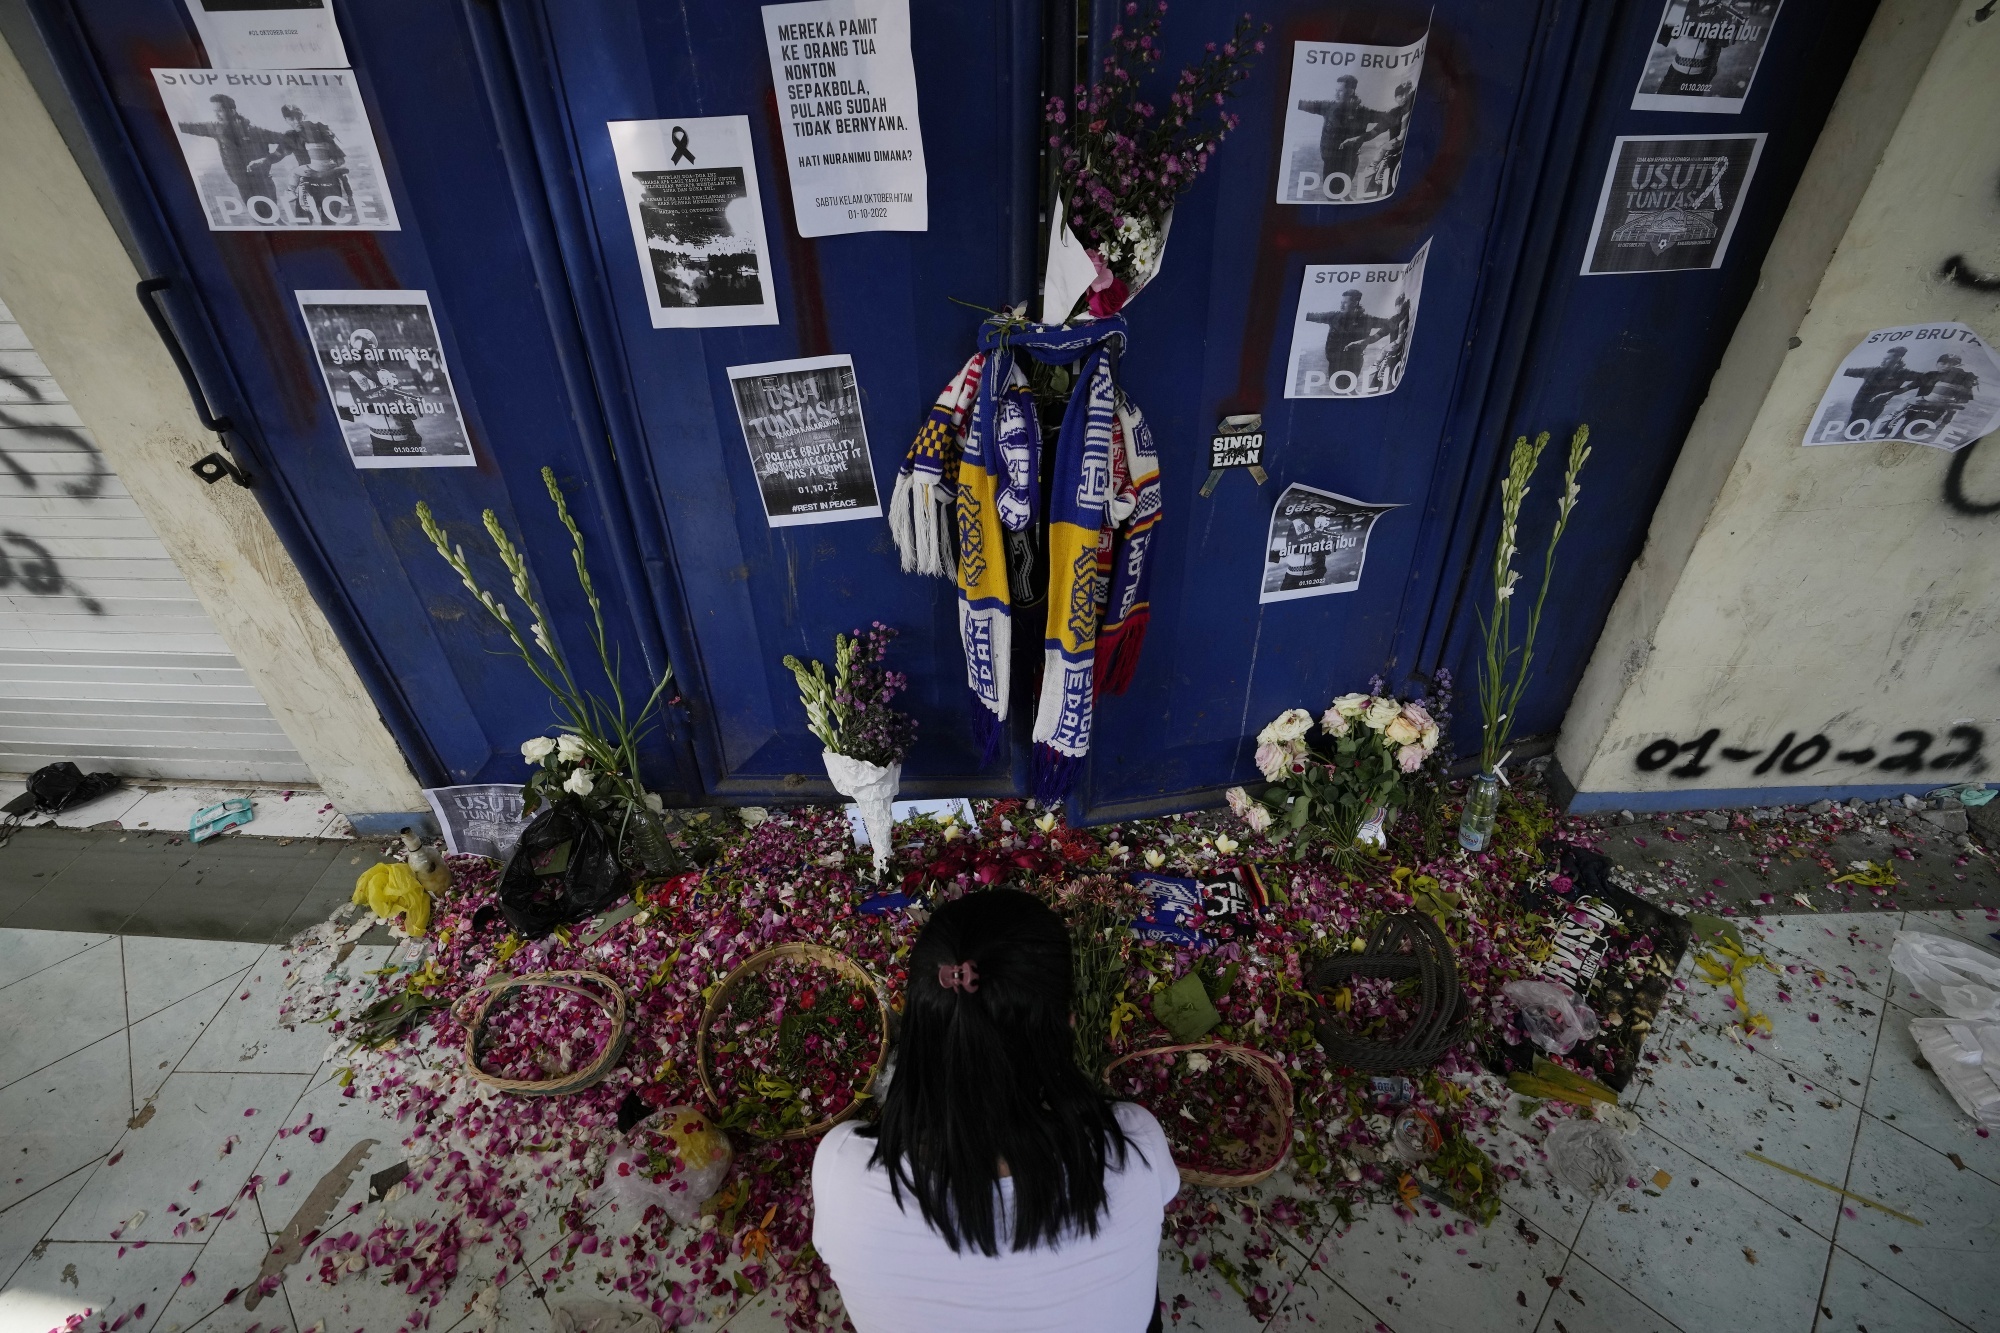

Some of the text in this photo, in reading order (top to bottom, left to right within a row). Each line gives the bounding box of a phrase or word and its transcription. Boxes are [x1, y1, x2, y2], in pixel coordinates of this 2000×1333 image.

[778, 18, 878, 42] MEREKA PAMIT
[1671, 15, 1761, 42] air mata ibu
[781, 39, 876, 61] KE ORANG TUA
[1306, 49, 1356, 67] STOP
[784, 62, 837, 81] NONTON
[787, 79, 870, 100] SEPAKBOLA,
[1680, 82, 1712, 92] 01.10.2022
[790, 97, 887, 120] PULANG SUDAH
[793, 115, 908, 137] TIDAK BERNYAWA.
[798, 150, 912, 168] HATI NURANIMU DIMANA?
[1631, 163, 1713, 190] USUT
[815, 193, 913, 207] SABTU KELAM OKTOBER HITAM
[1626, 190, 1697, 209] TUNTAS
[215, 195, 382, 225] POLICE
[848, 207, 888, 220] 01-10-2022
[1314, 271, 1361, 284] STOP
[1867, 330, 1913, 344] STOP
[330, 347, 429, 365] gas air mata
[766, 376, 821, 410] USUT
[350, 398, 445, 415] air mata ibu
[1820, 418, 1963, 448] POLICE
[765, 438, 856, 462] POLICE BRUTALITY
[1213, 434, 1263, 452] SINGO
[803, 450, 849, 467] ACCIDENT
[851, 447, 861, 458] IT
[1212, 450, 1260, 468] EDAN
[784, 461, 849, 480] WAS A CRIME
[792, 498, 857, 512] #REST IN PEACE
[1285, 502, 1312, 515] gas
[1279, 535, 1357, 558] air mata ibu
[1299, 578, 1326, 586] 01.10.2022
[974, 616, 995, 700] EDAN
[1058, 671, 1085, 746] EDAN
[1635, 726, 1988, 778] 01-10-22
[454, 796, 521, 813] USUT
